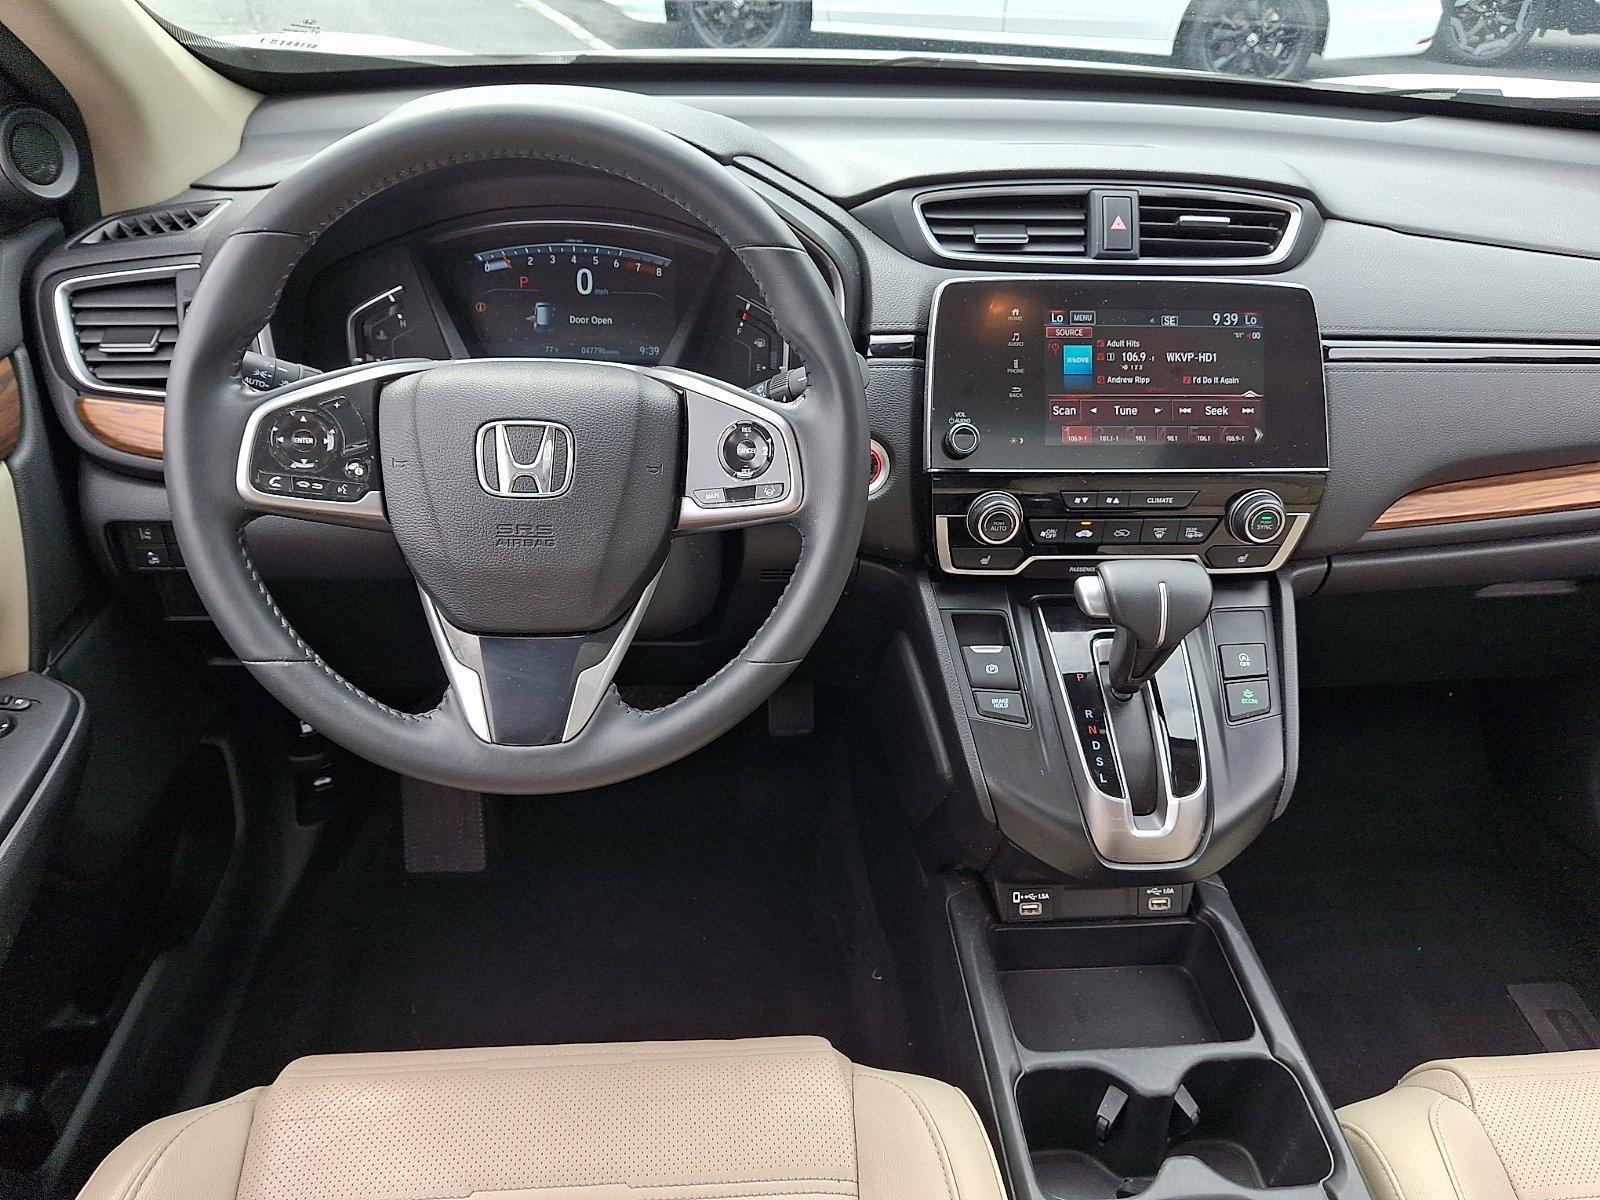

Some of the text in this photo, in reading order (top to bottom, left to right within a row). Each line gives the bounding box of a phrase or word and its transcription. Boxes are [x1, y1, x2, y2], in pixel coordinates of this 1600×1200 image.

[527, 256, 534, 266] 2
[550, 254, 556, 264] 3
[570, 255, 577, 264] 4
[593, 255, 599, 265] 5
[613, 258, 620, 268] 6
[635, 262, 641, 272] 7
[656, 267, 662, 277] 8
[519, 276, 529, 288] P
[576, 268, 609, 296] 0 mph
[569, 315, 613, 326] Door Open
[1051, 312, 1064, 323] Lo
[1073, 314, 1093, 322] MENU
[1244, 315, 1257, 325] Lo
[1055, 328, 1084, 337] SOURCE
[1106, 340, 1140, 348] Adult Hits
[639, 346, 660, 356] 9:39
[1121, 352, 1147, 362] 106.9
[1166, 352, 1217, 363] WKVP-HD1
[756, 364, 762, 372] E
[244, 376, 266, 388] AUTO
[1107, 376, 1150, 384] Andrew Ripp
[1202, 376, 1212, 384] Do
[1220, 376, 1239, 385] Again
[1052, 405, 1077, 415] Scan
[1114, 405, 1138, 415] Tune
[1205, 406, 1229, 416] Seek
[294, 437, 314, 445] ENTER
[496, 523, 556, 536] SRS
[495, 538, 556, 547] AIRBAG
[1084, 709, 1094, 719] R
[1088, 725, 1098, 735] N
[1092, 740, 1101, 750] D
[1096, 757, 1104, 767] S
[1100, 774, 1108, 783] L
